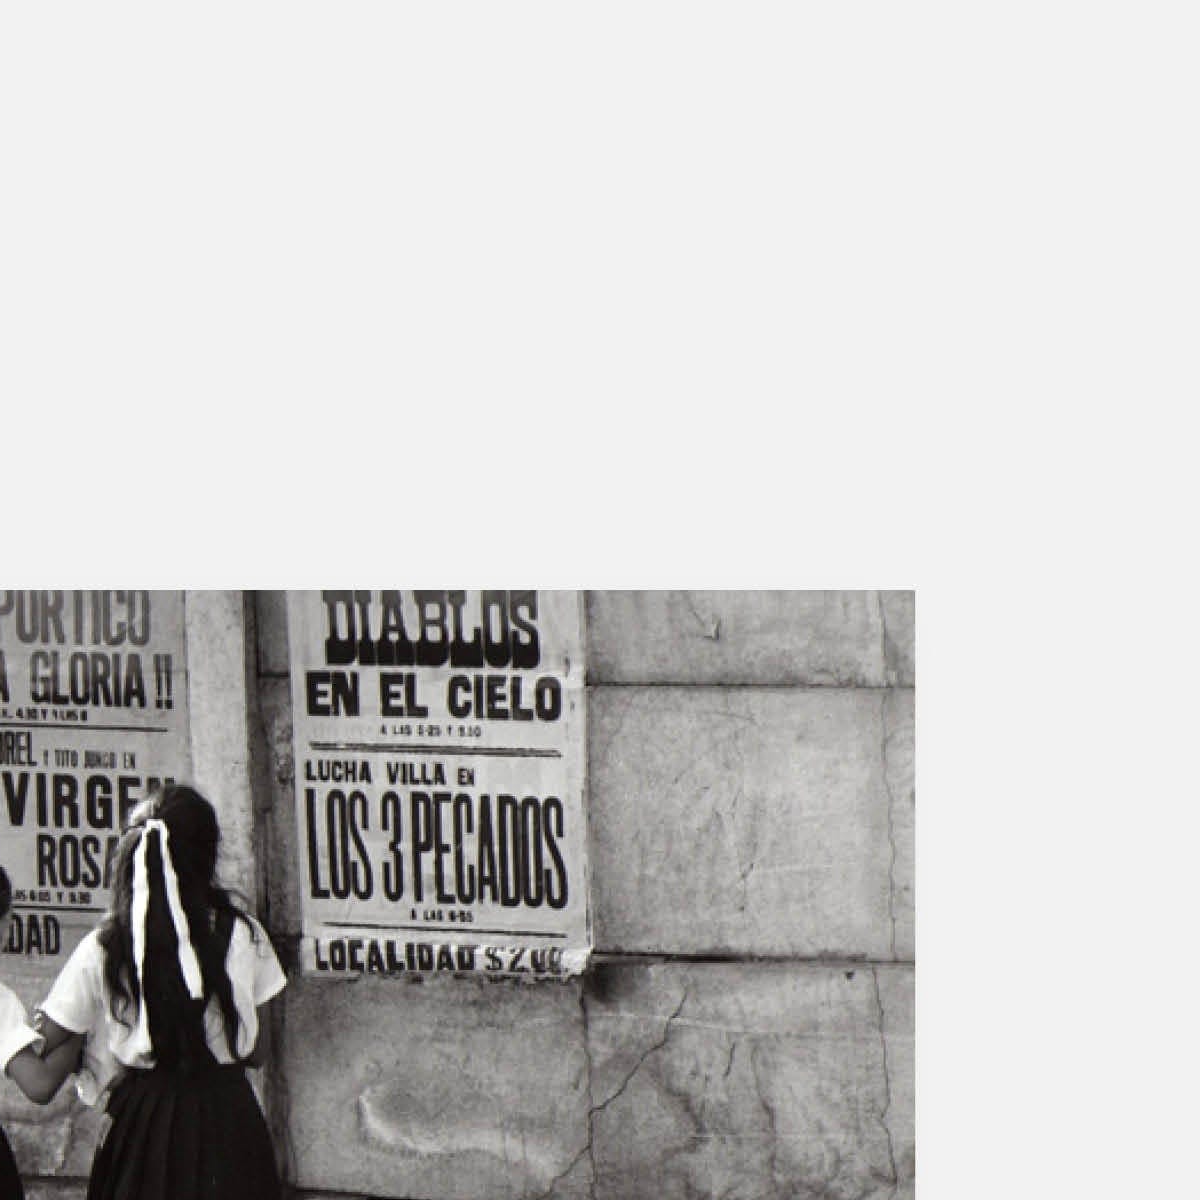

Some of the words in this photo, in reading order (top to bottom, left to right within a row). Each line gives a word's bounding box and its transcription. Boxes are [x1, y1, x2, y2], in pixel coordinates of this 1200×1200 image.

[322, 590, 540, 669] DIABLOS
[306, 671, 360, 717] EN
[379, 671, 429, 718] EL
[448, 674, 562, 722] CIELO
[305, 760, 372, 784] LUCHA
[386, 761, 447, 785] VILLA
[457, 767, 475, 785] EN
[2, 771, 176, 830] VIRGE
[305, 789, 374, 900] LOS
[381, 791, 404, 902] 3
[410, 791, 569, 909] PECADOS
[315, 938, 478, 974] LOCALIDAD
